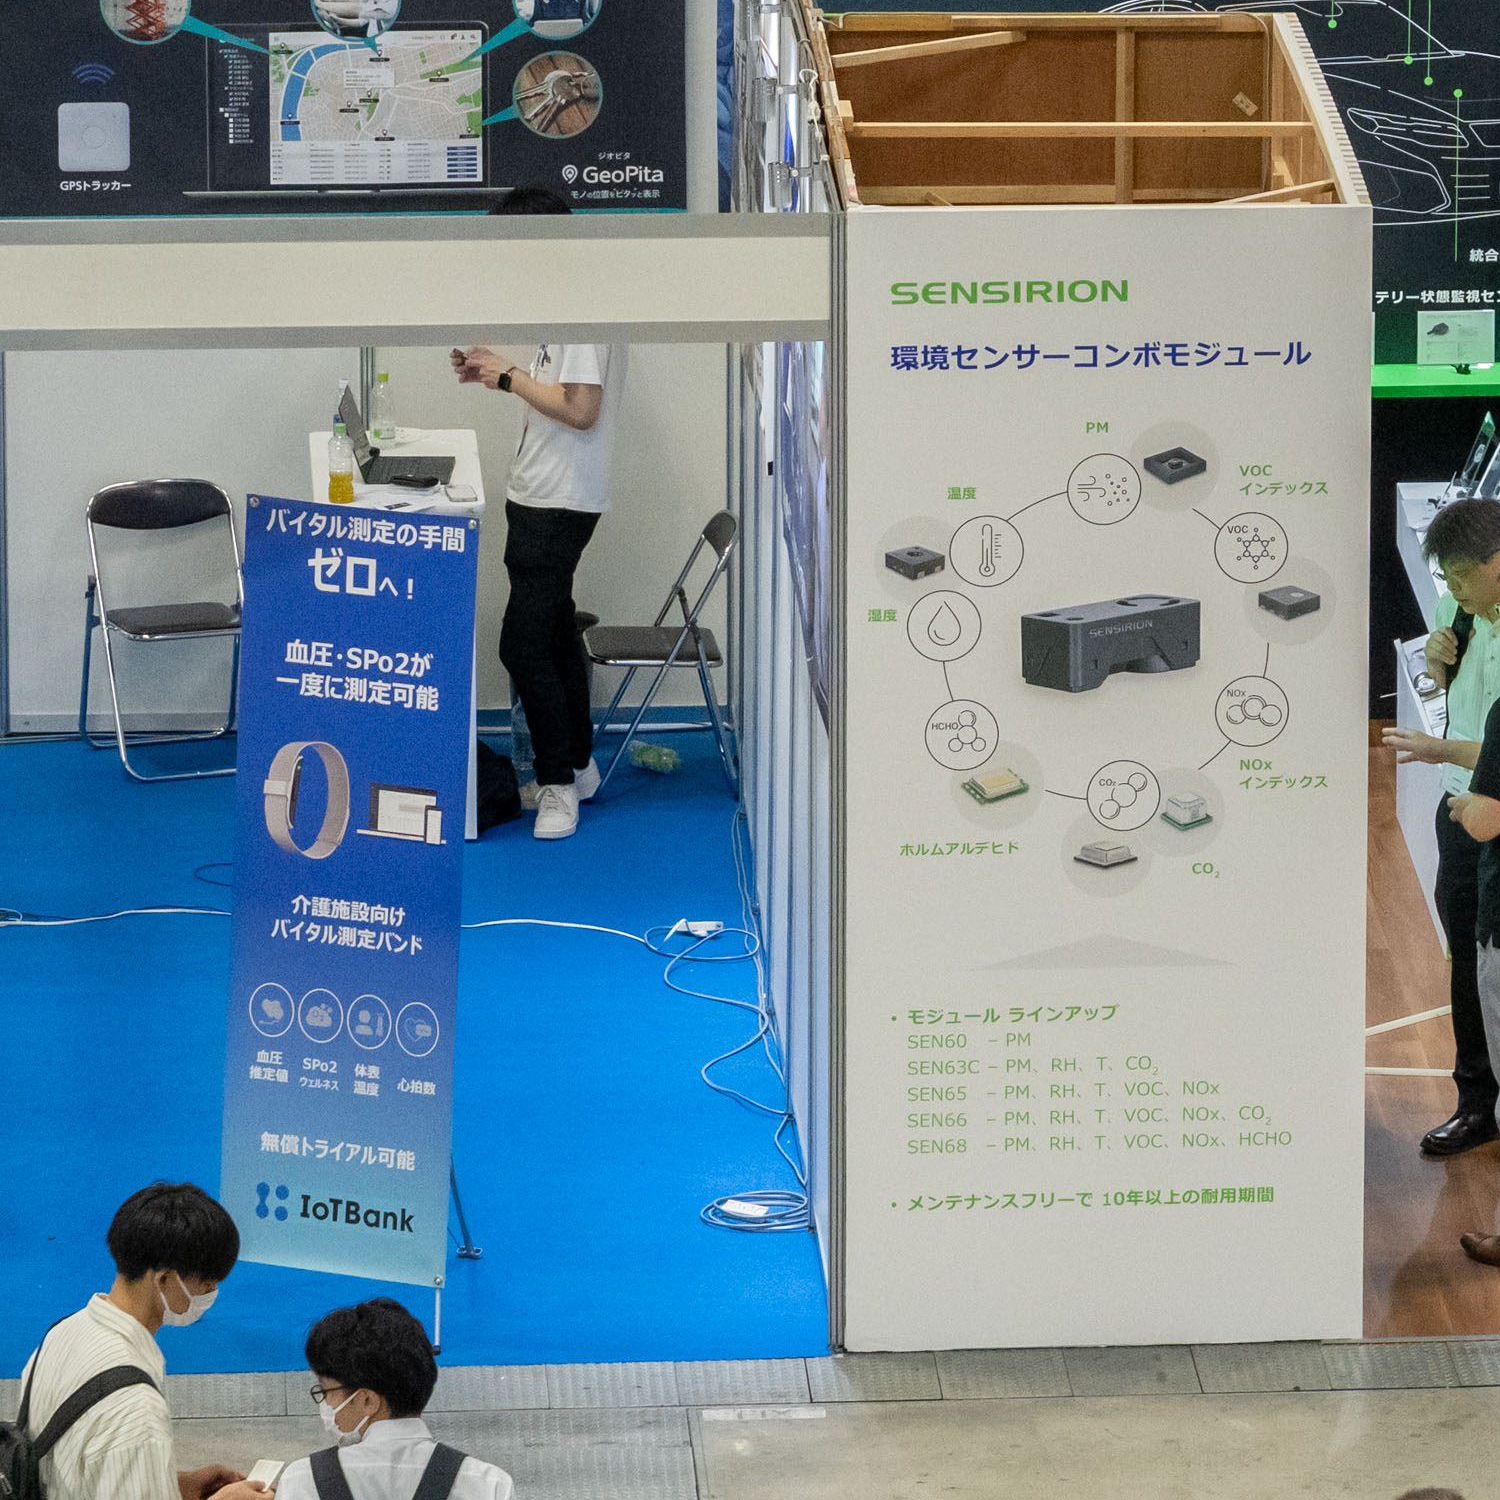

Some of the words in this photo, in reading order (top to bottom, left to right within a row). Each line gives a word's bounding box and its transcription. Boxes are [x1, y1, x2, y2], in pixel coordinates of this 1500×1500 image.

[598, 152, 631, 160] ジオピタ
[583, 166, 664, 185] GeoPita
[59, 179, 132, 192] GPSトラッカー
[571, 187, 660, 199] モノの位置をピタッと表示
[890, 279, 1129, 305] SENSIRION
[890, 341, 1312, 371] 環境センサーコンボモジュール
[1086, 421, 1109, 434] PM
[1239, 464, 1273, 477] VOC
[947, 486, 977, 501] 温度
[1239, 482, 1329, 497] インデックス
[267, 508, 465, 553] バイタル測定の手間
[1227, 525, 1249, 534] VOC
[1089, 619, 1153, 637] SENSIRION
[285, 639, 433, 678] 血圧・SPo2が
[276, 674, 439, 712] 一度に測定可能
[1227, 689, 1246, 698] NOx
[931, 722, 959, 731] HCHO
[1239, 759, 1272, 771] NOx
[1239, 775, 1328, 790] インデックス
[900, 842, 1020, 857] ホルムアルデヒド
[291, 895, 405, 926] 介護施設向け
[271, 919, 423, 955] バイタル測定バンド
[907, 1008, 1000, 1025] モジュール
[1008, 1004, 1119, 1023] ラインアップ
[907, 1033, 967, 1049] SEN60
[1006, 1032, 1031, 1047] PM
[256, 1050, 283, 1065] 血圧
[302, 1057, 338, 1074] SPo2
[249, 1065, 289, 1084] 推定値
[354, 1064, 380, 1080] 体表
[907, 1059, 980, 1075] SEN63C
[299, 1076, 339, 1091] ウェルネス
[353, 1081, 380, 1097] 温度
[397, 1077, 436, 1096] 心拍数
[907, 1085, 967, 1102] SEN65
[907, 1111, 967, 1128] SEN66
[260, 1132, 416, 1171] 無償トライアル可能
[907, 1138, 967, 1154] SEN68
[907, 1192, 1093, 1211] メンテナンスフリーで
[1102, 1186, 1274, 1208] 10年以上の耐用期間
[301, 1194, 414, 1232] IoTBank
